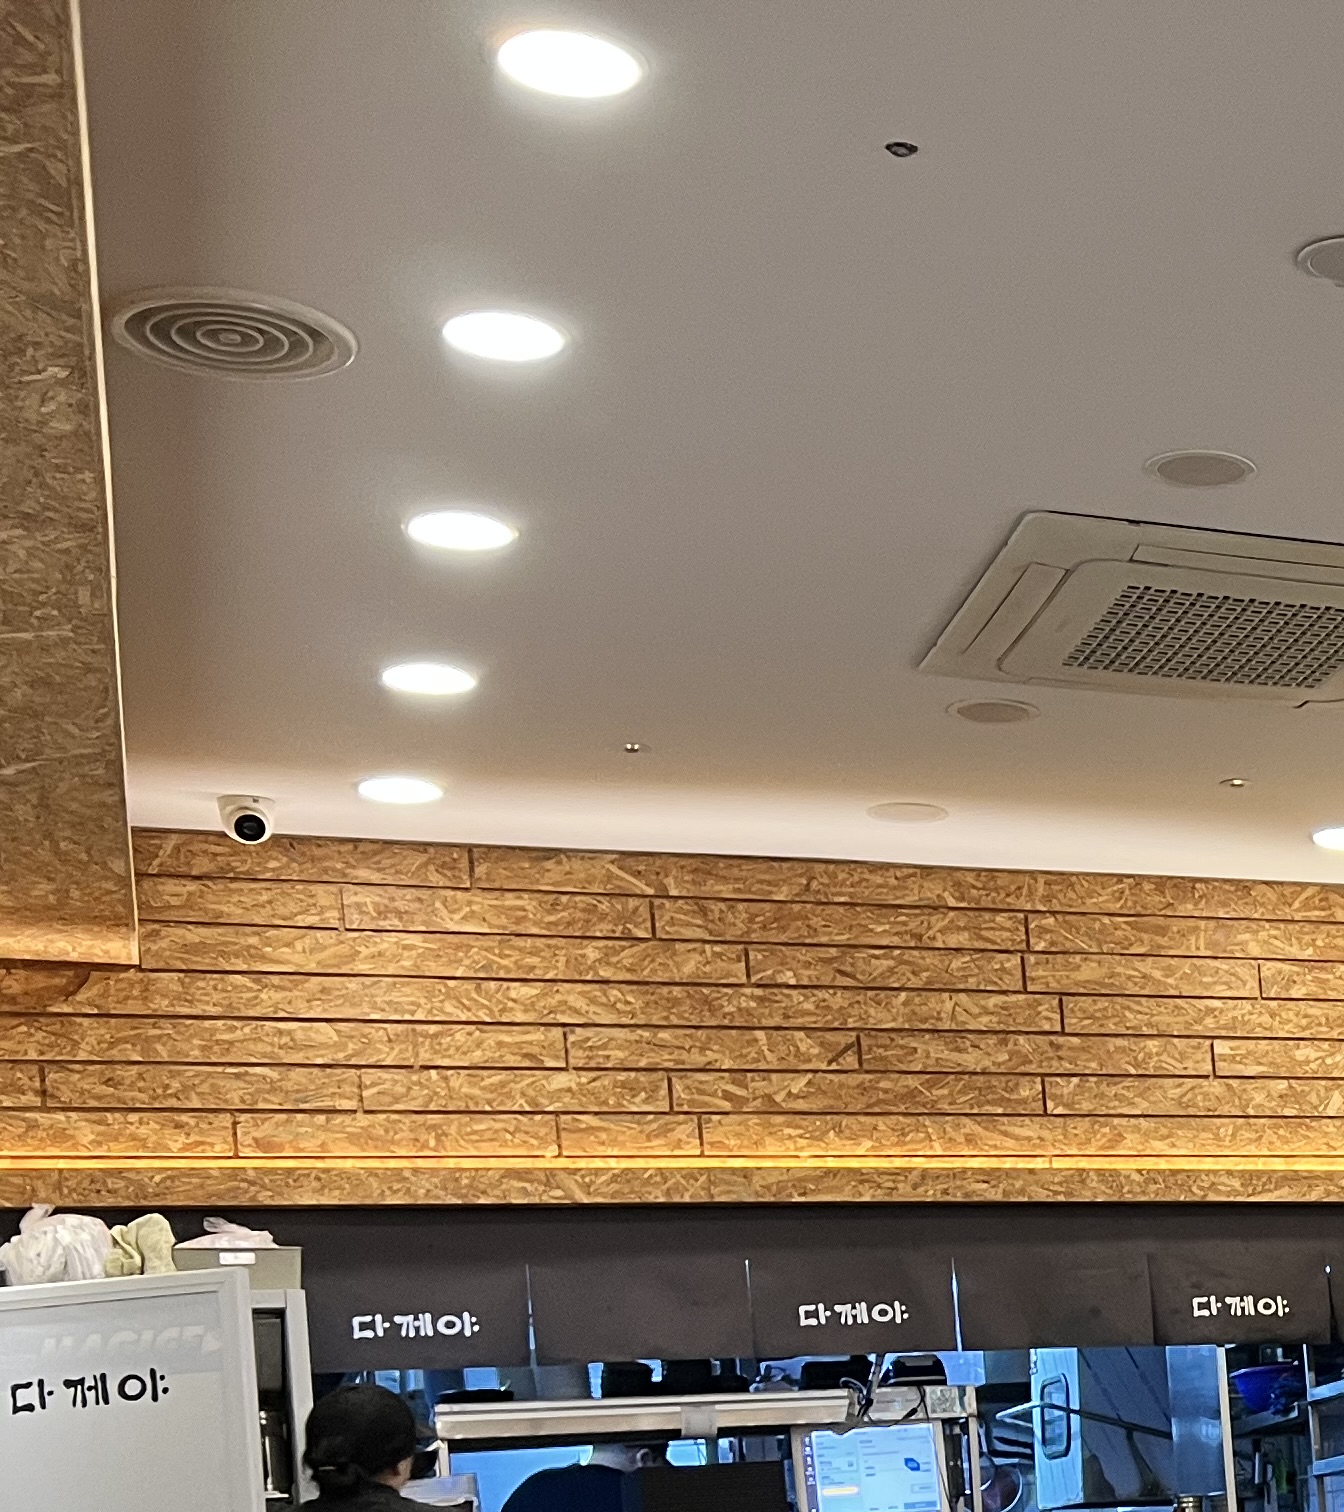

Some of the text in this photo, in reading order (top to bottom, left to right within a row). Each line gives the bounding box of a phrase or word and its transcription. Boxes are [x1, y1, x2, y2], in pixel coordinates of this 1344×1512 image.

[798, 1300, 909, 1327] 다께야
[1192, 1295, 1290, 1318] 다께야
[352, 1311, 480, 1339] 다께야
[10, 1367, 169, 1415] 다께야
